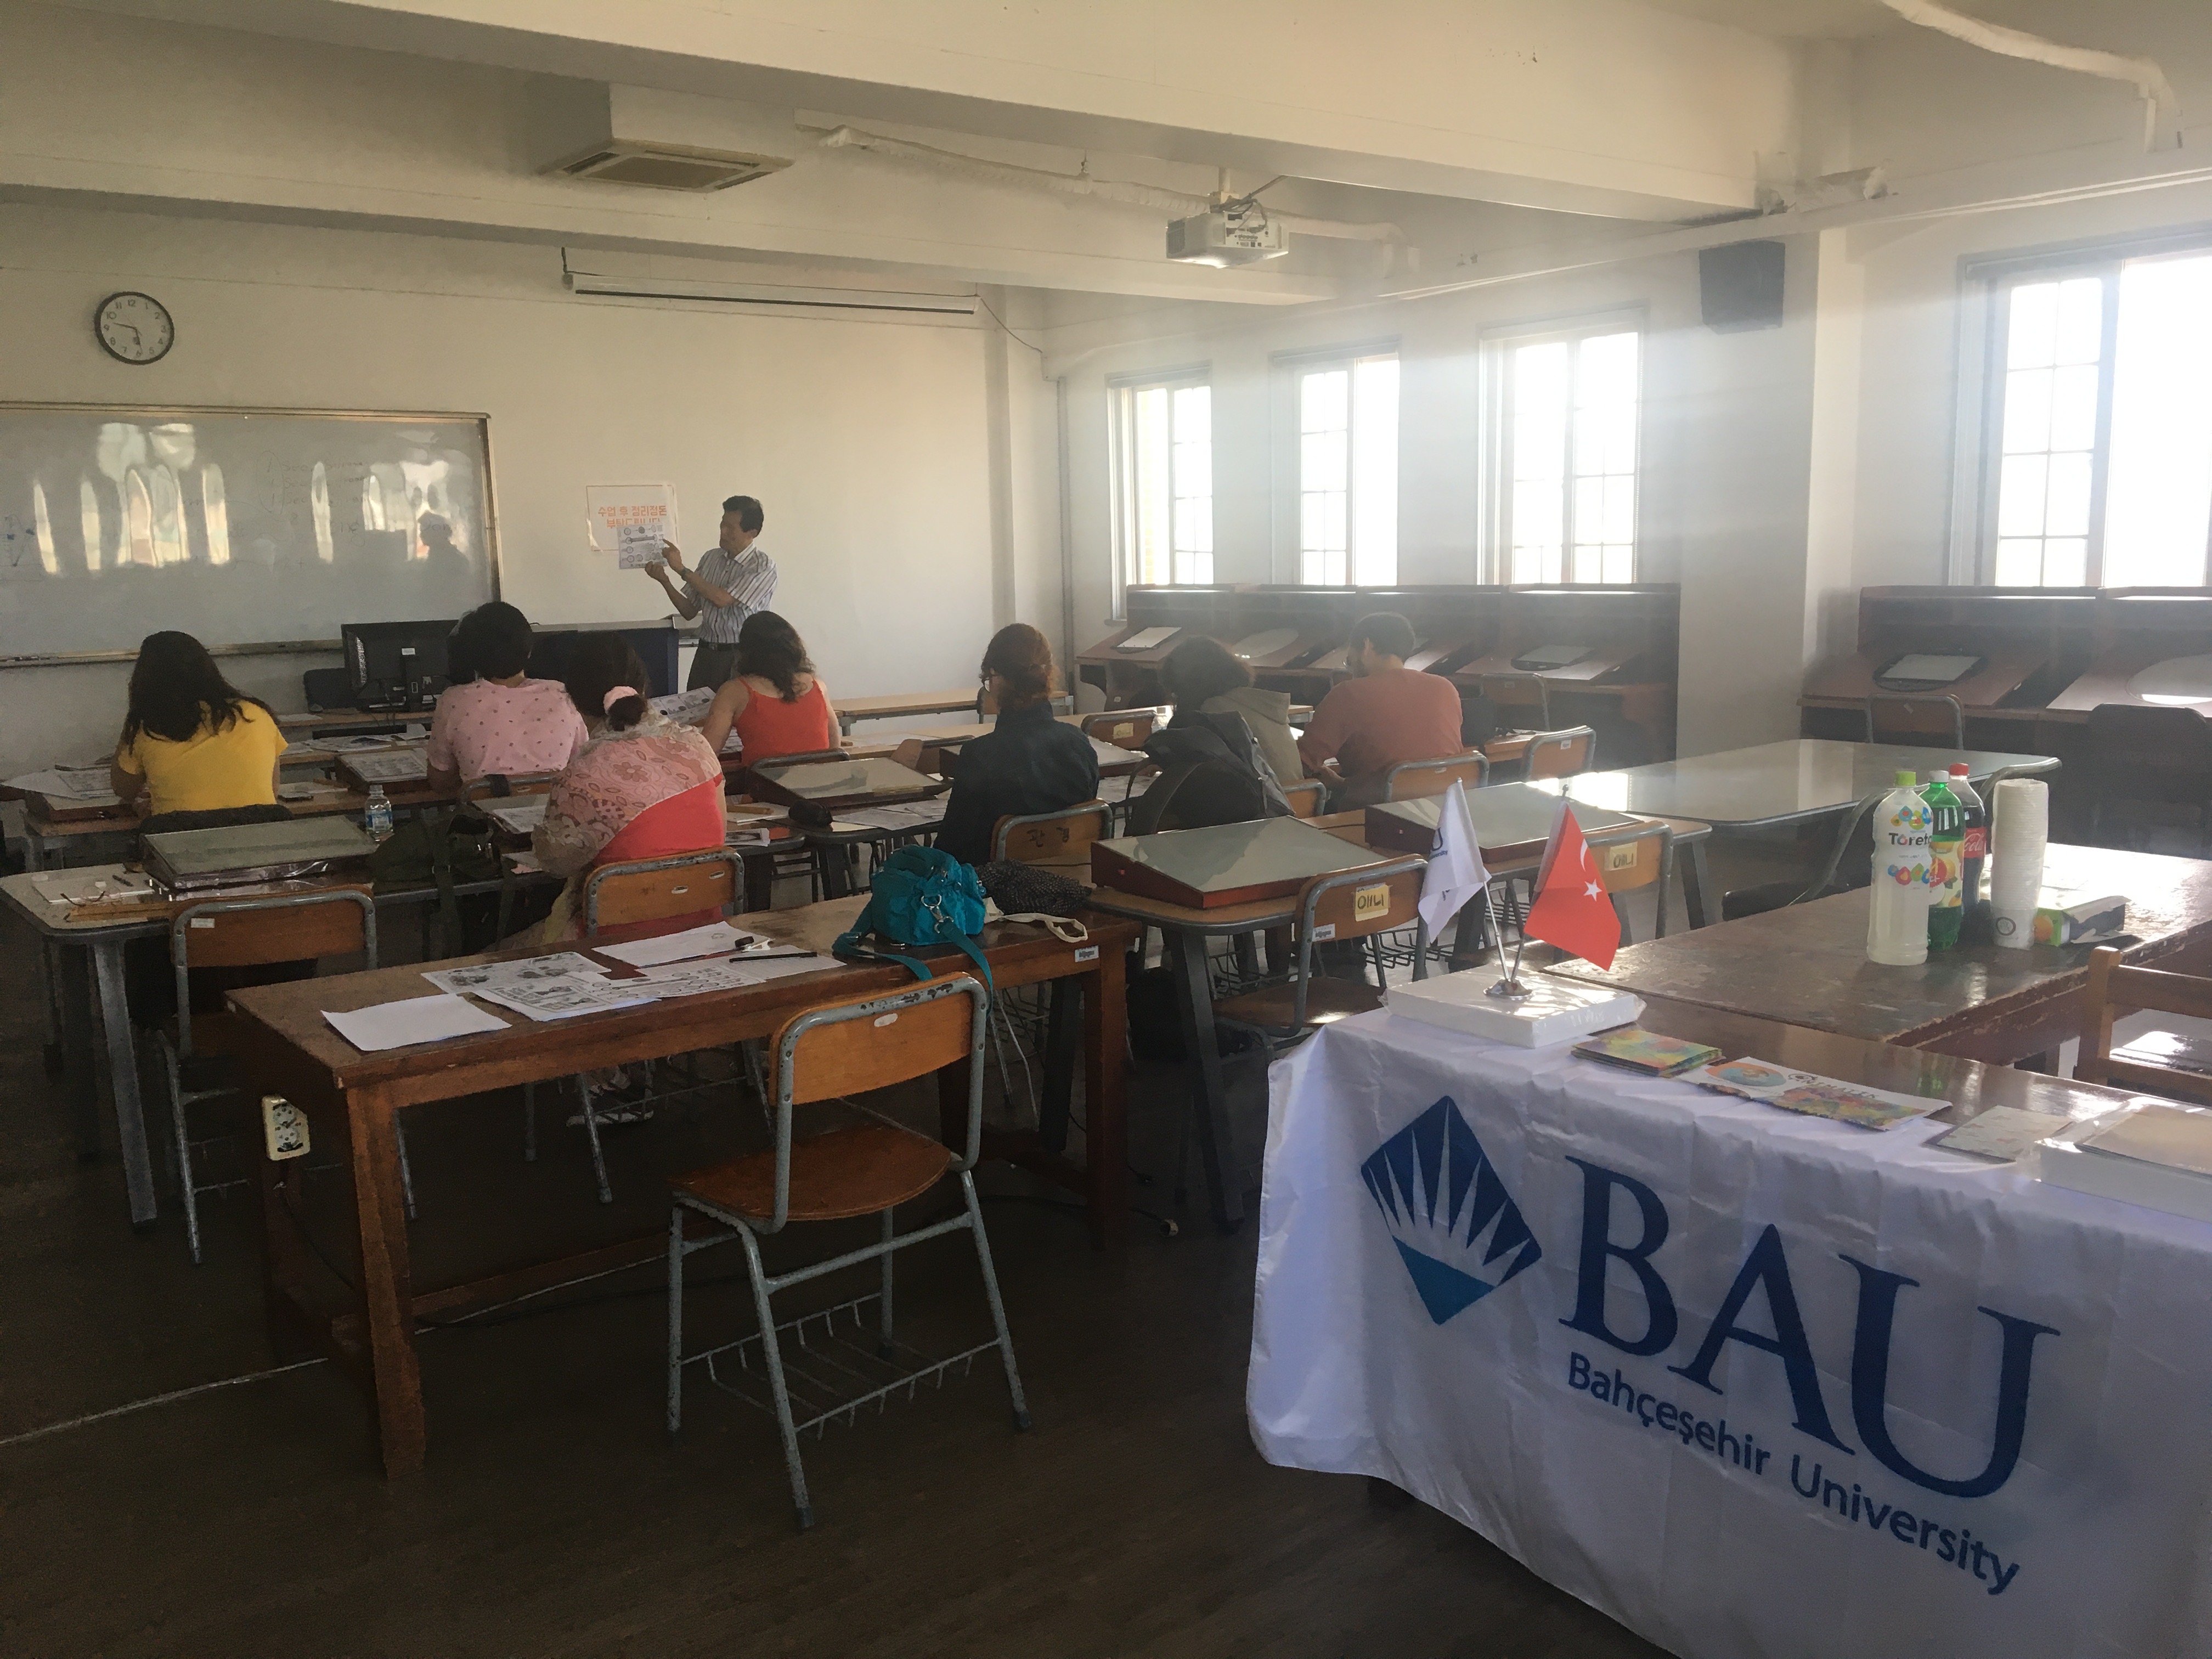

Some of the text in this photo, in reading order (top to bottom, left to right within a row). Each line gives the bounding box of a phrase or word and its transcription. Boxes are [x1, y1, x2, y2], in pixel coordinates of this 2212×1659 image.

[127, 299, 137, 307] 12
[106, 311, 117, 319] 10
[161, 325, 166, 333] 3
[110, 336, 116, 346] 8
[121, 346, 128, 354] 7
[149, 346, 155, 354] 5
[598, 505, 667, 517] 수업 후 정리정돈
[1559, 1155, 2061, 1498] BAU
[1568, 1352, 2020, 1596] Bahçeşehir University
